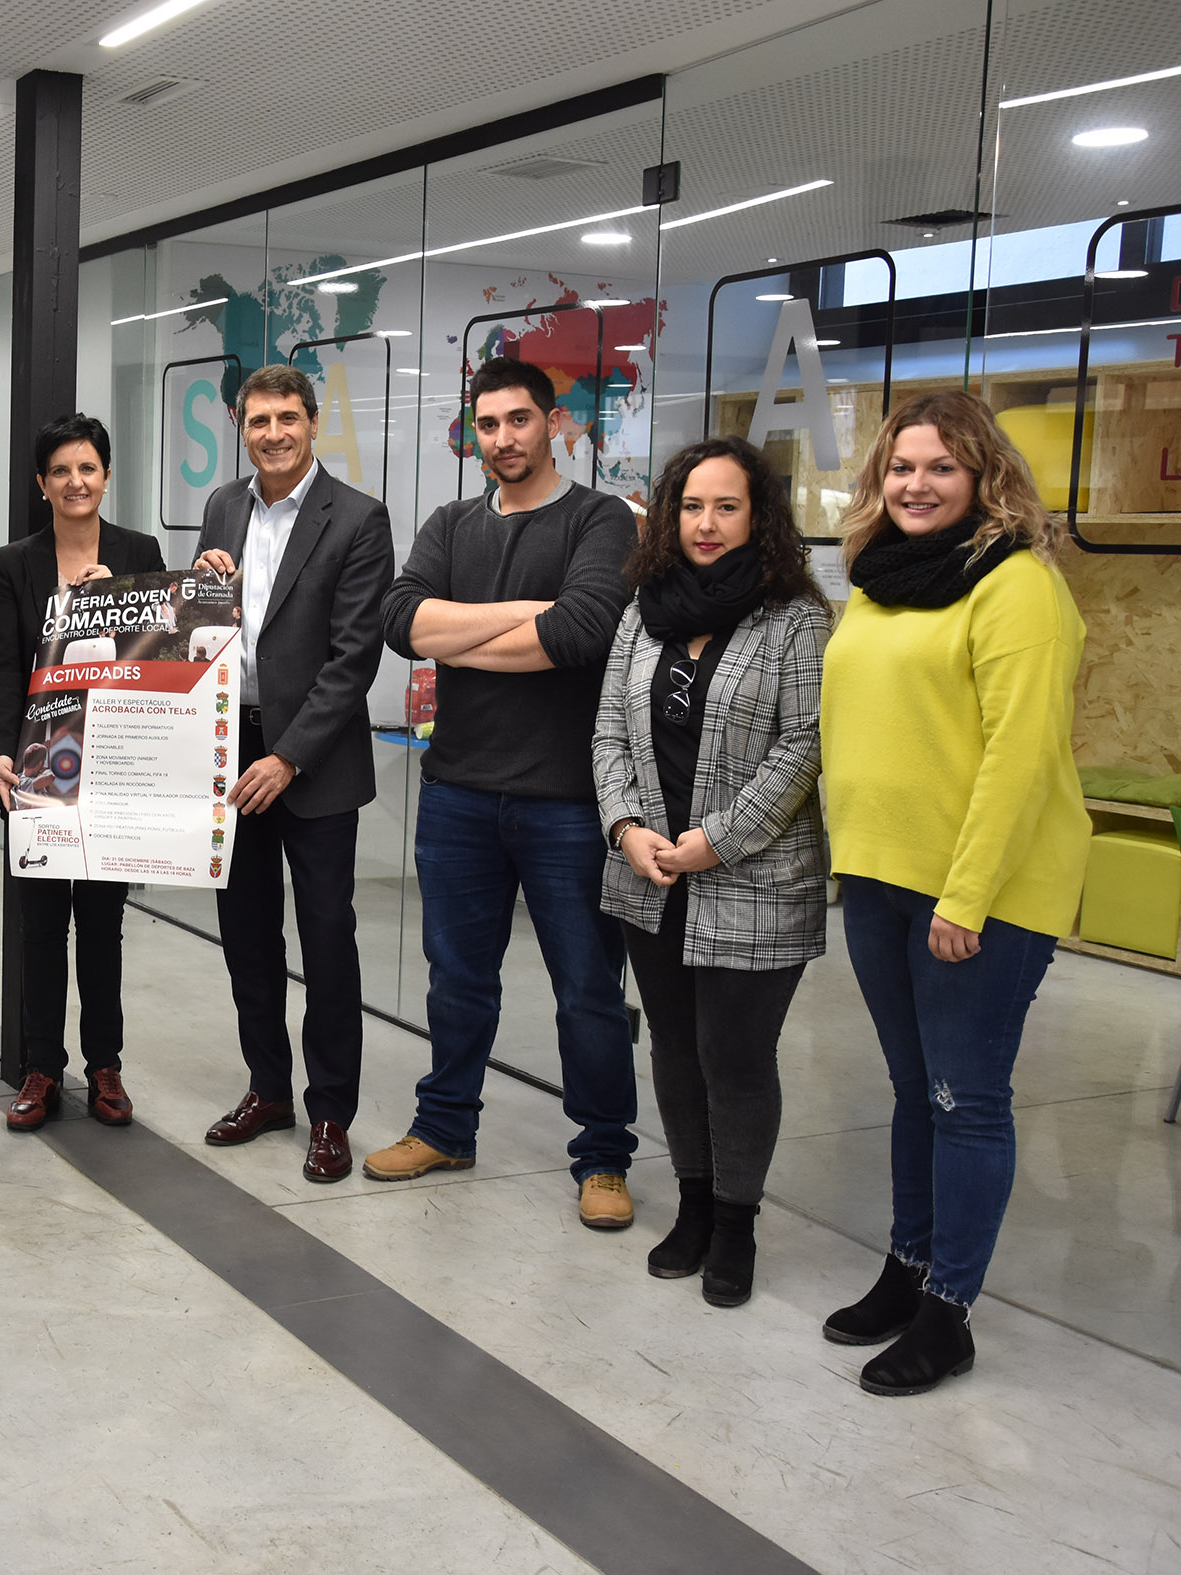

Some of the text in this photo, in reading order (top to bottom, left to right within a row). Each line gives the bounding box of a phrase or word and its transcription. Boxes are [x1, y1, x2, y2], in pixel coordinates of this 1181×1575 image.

[746, 298, 840, 470] A
[198, 583, 234, 593] Diputación
[206, 591, 234, 599] Granada
[45, 589, 171, 620] IV FERIA JOVEN
[42, 606, 170, 637] COMARCAL
[41, 623, 171, 644] ENCUENTRO DEL DEPORTE LOCAL
[43, 666, 141, 685] ACTIVIDADES
[25, 694, 74, 720] Conéctate
[41, 704, 82, 721] CON TU COMARCA
[92, 705, 197, 715] ACROBACIA CON TELAS
